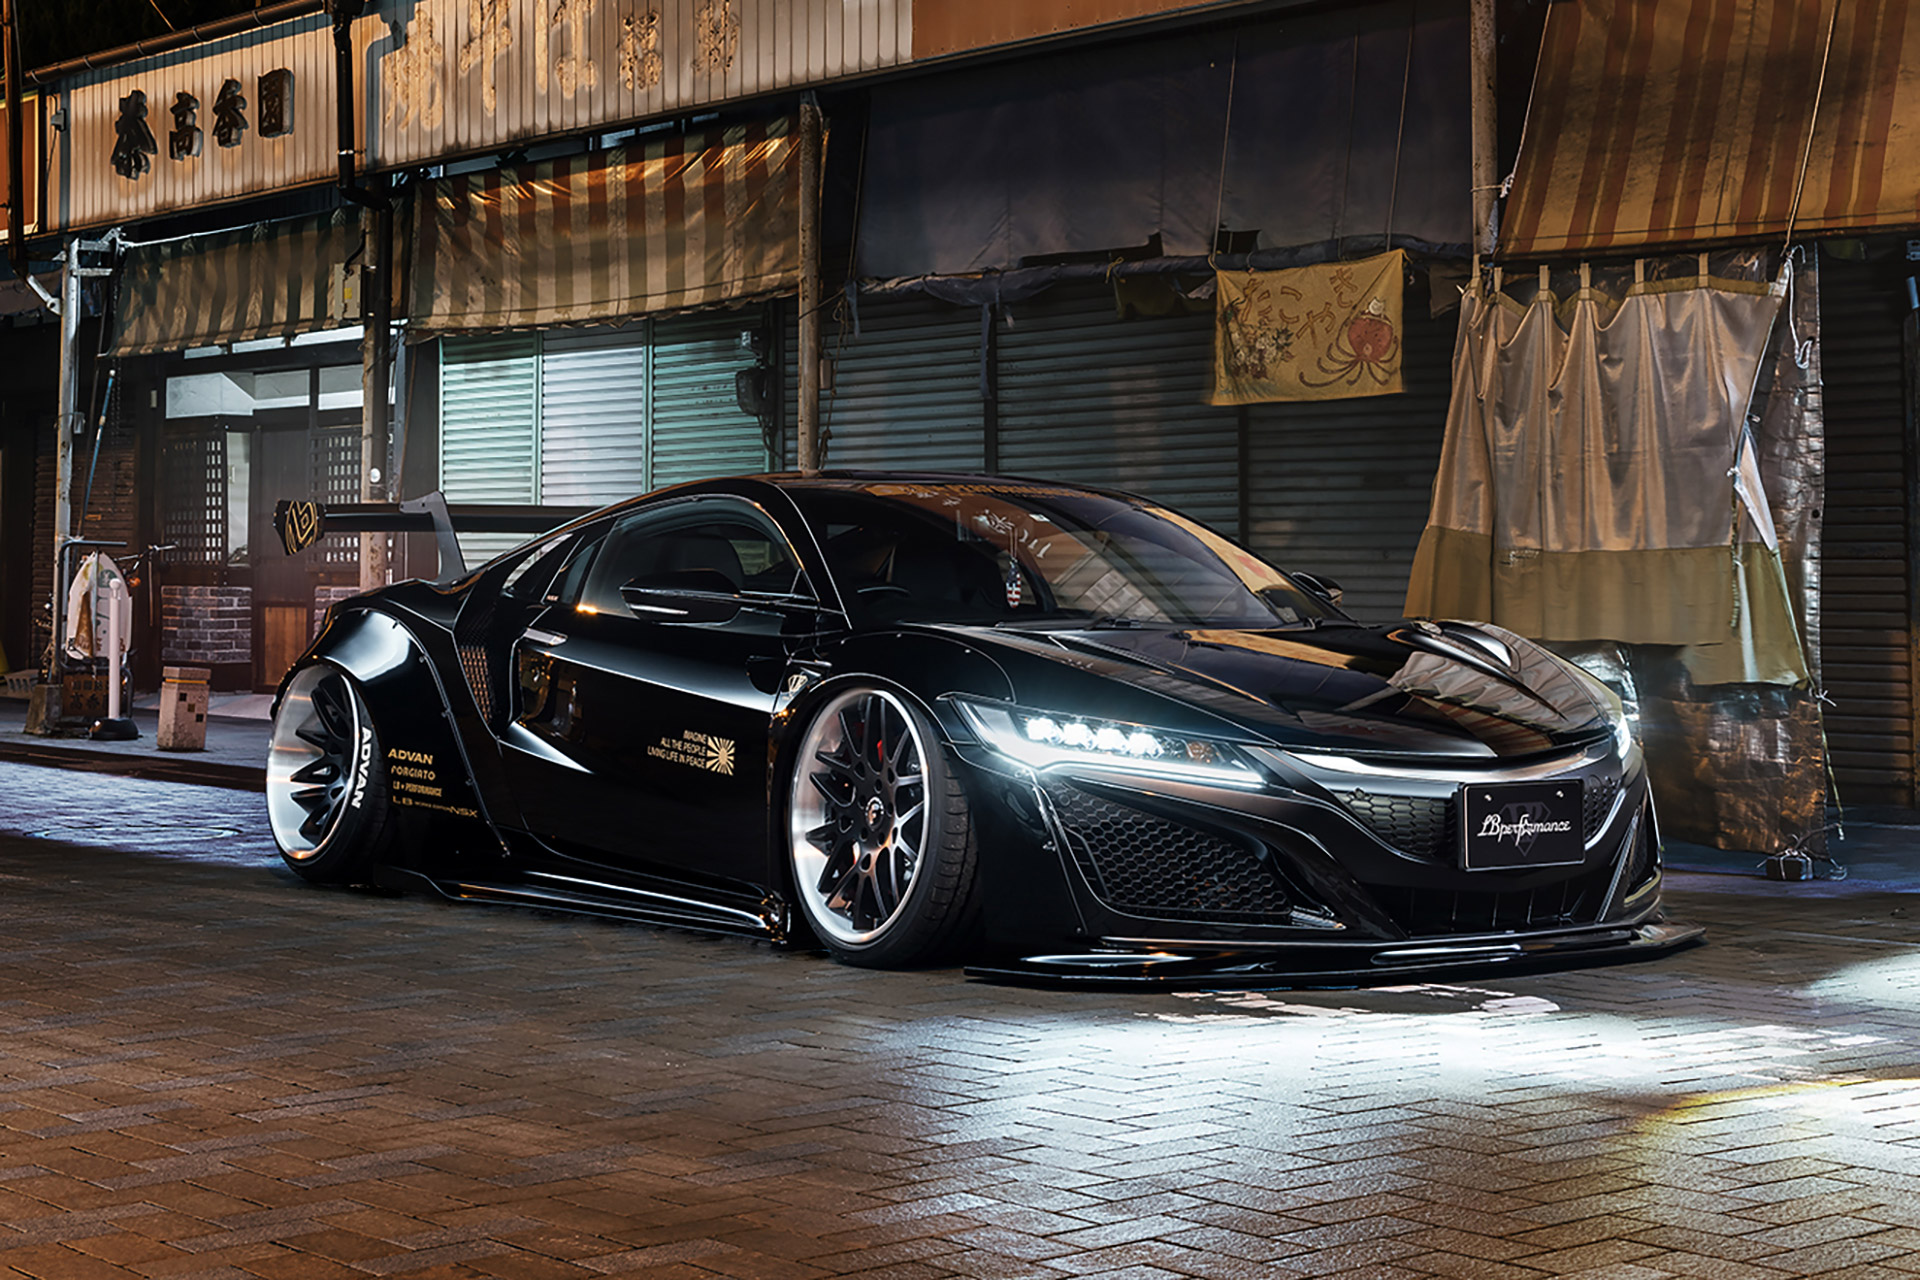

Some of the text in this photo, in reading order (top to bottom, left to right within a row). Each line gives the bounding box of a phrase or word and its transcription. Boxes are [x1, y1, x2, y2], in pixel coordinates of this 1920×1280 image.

[683, 730, 707, 744] IMAGINE
[660, 737, 706, 757] ALL THE PEOPLE
[388, 748, 433, 765] ADVAN
[647, 745, 705, 769] LIVING LIFE IN PEACE
[351, 726, 372, 809] ADVAN
[391, 765, 436, 781] FORGIATO
